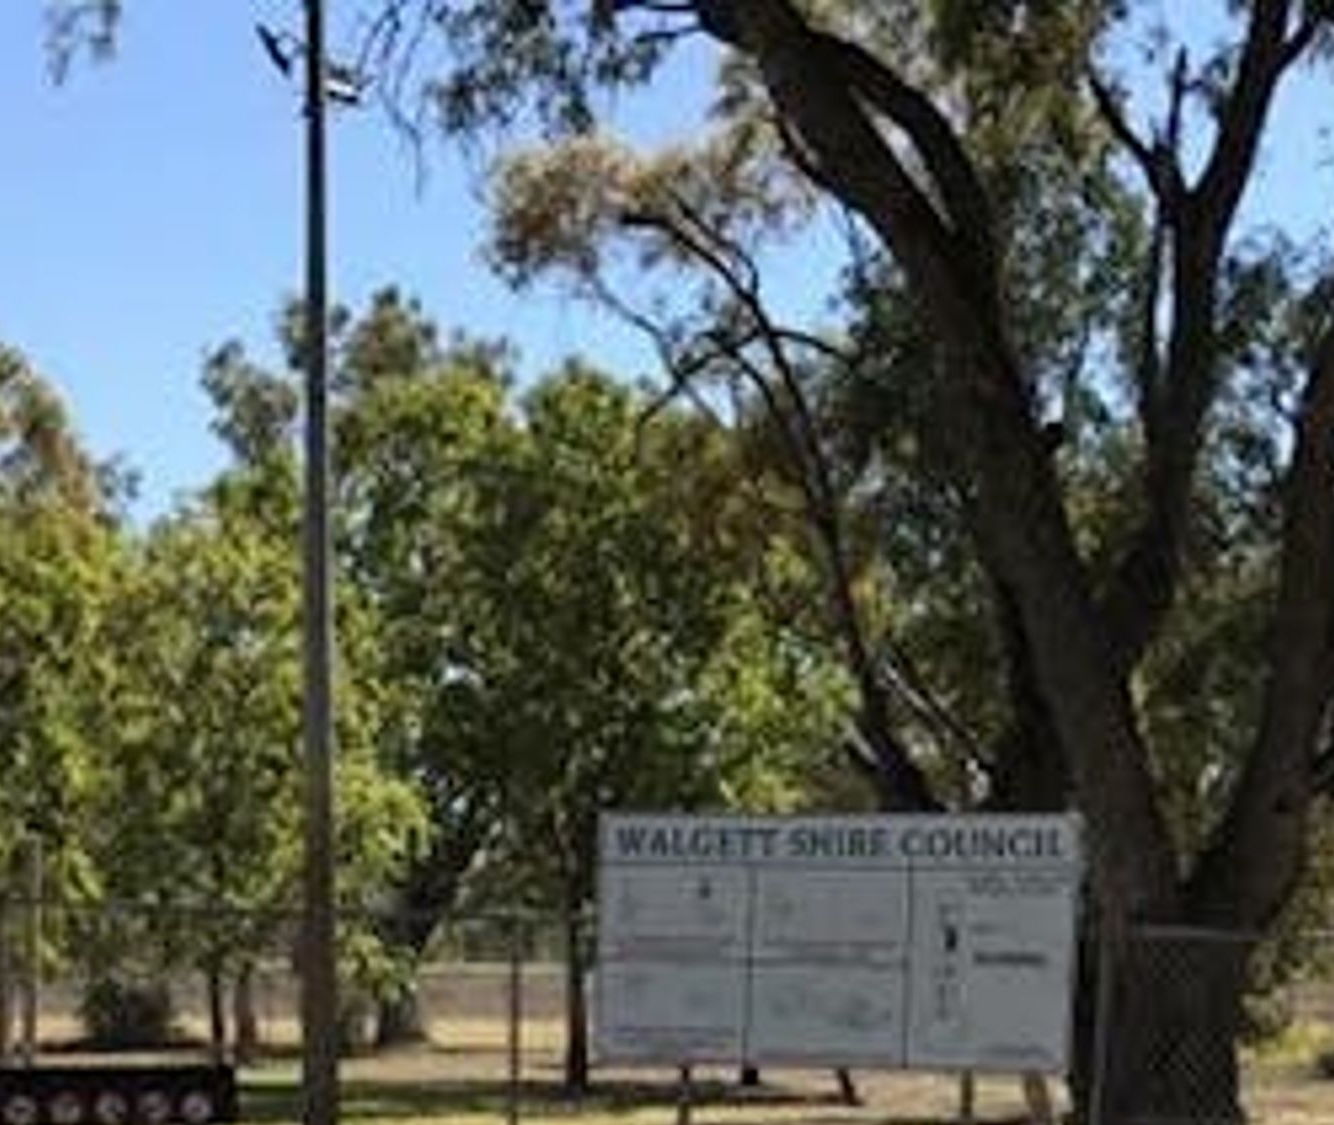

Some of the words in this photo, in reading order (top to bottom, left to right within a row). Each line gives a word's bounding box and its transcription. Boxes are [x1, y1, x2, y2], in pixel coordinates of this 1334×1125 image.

[615, 827, 778, 857] WALGETT
[788, 827, 891, 857] SHIRE
[901, 827, 1063, 858] COUNCIL
